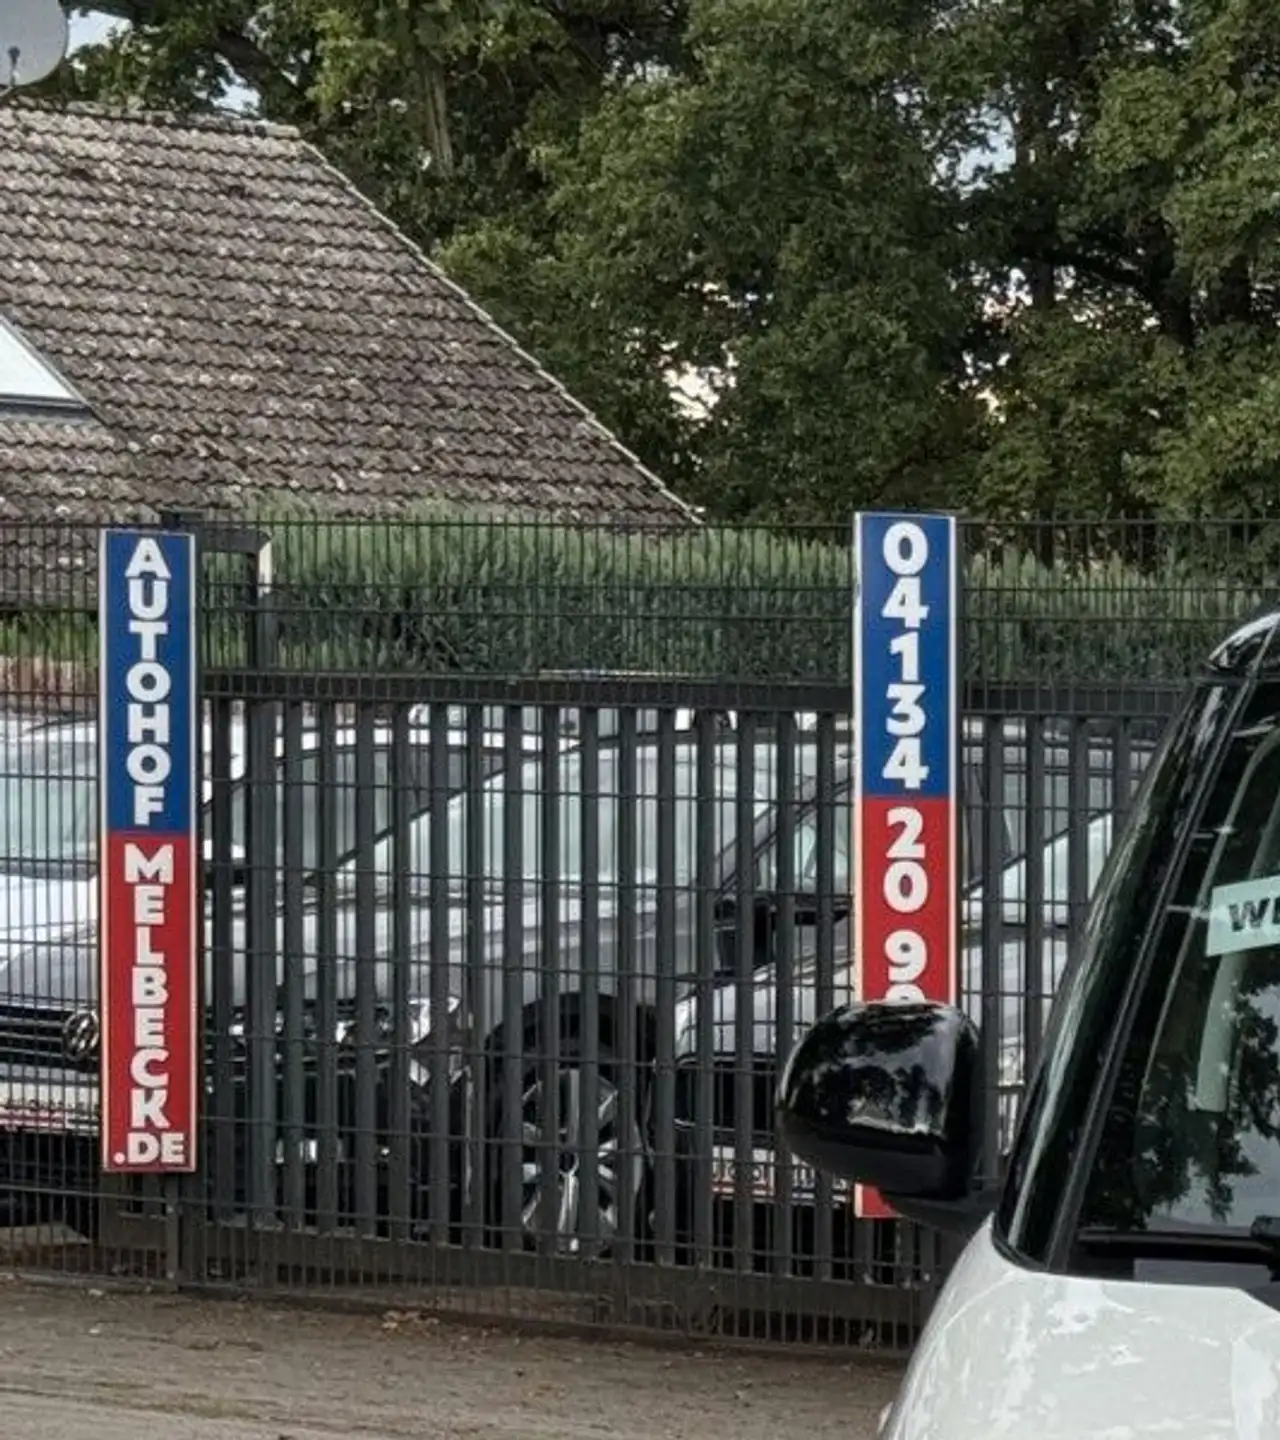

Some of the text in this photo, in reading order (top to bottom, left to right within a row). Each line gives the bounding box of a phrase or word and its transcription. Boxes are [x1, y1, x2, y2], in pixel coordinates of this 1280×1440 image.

[124, 537, 173, 826] AUTOHOF
[881, 521, 930, 789] 04134
[884, 806, 929, 913] 20
